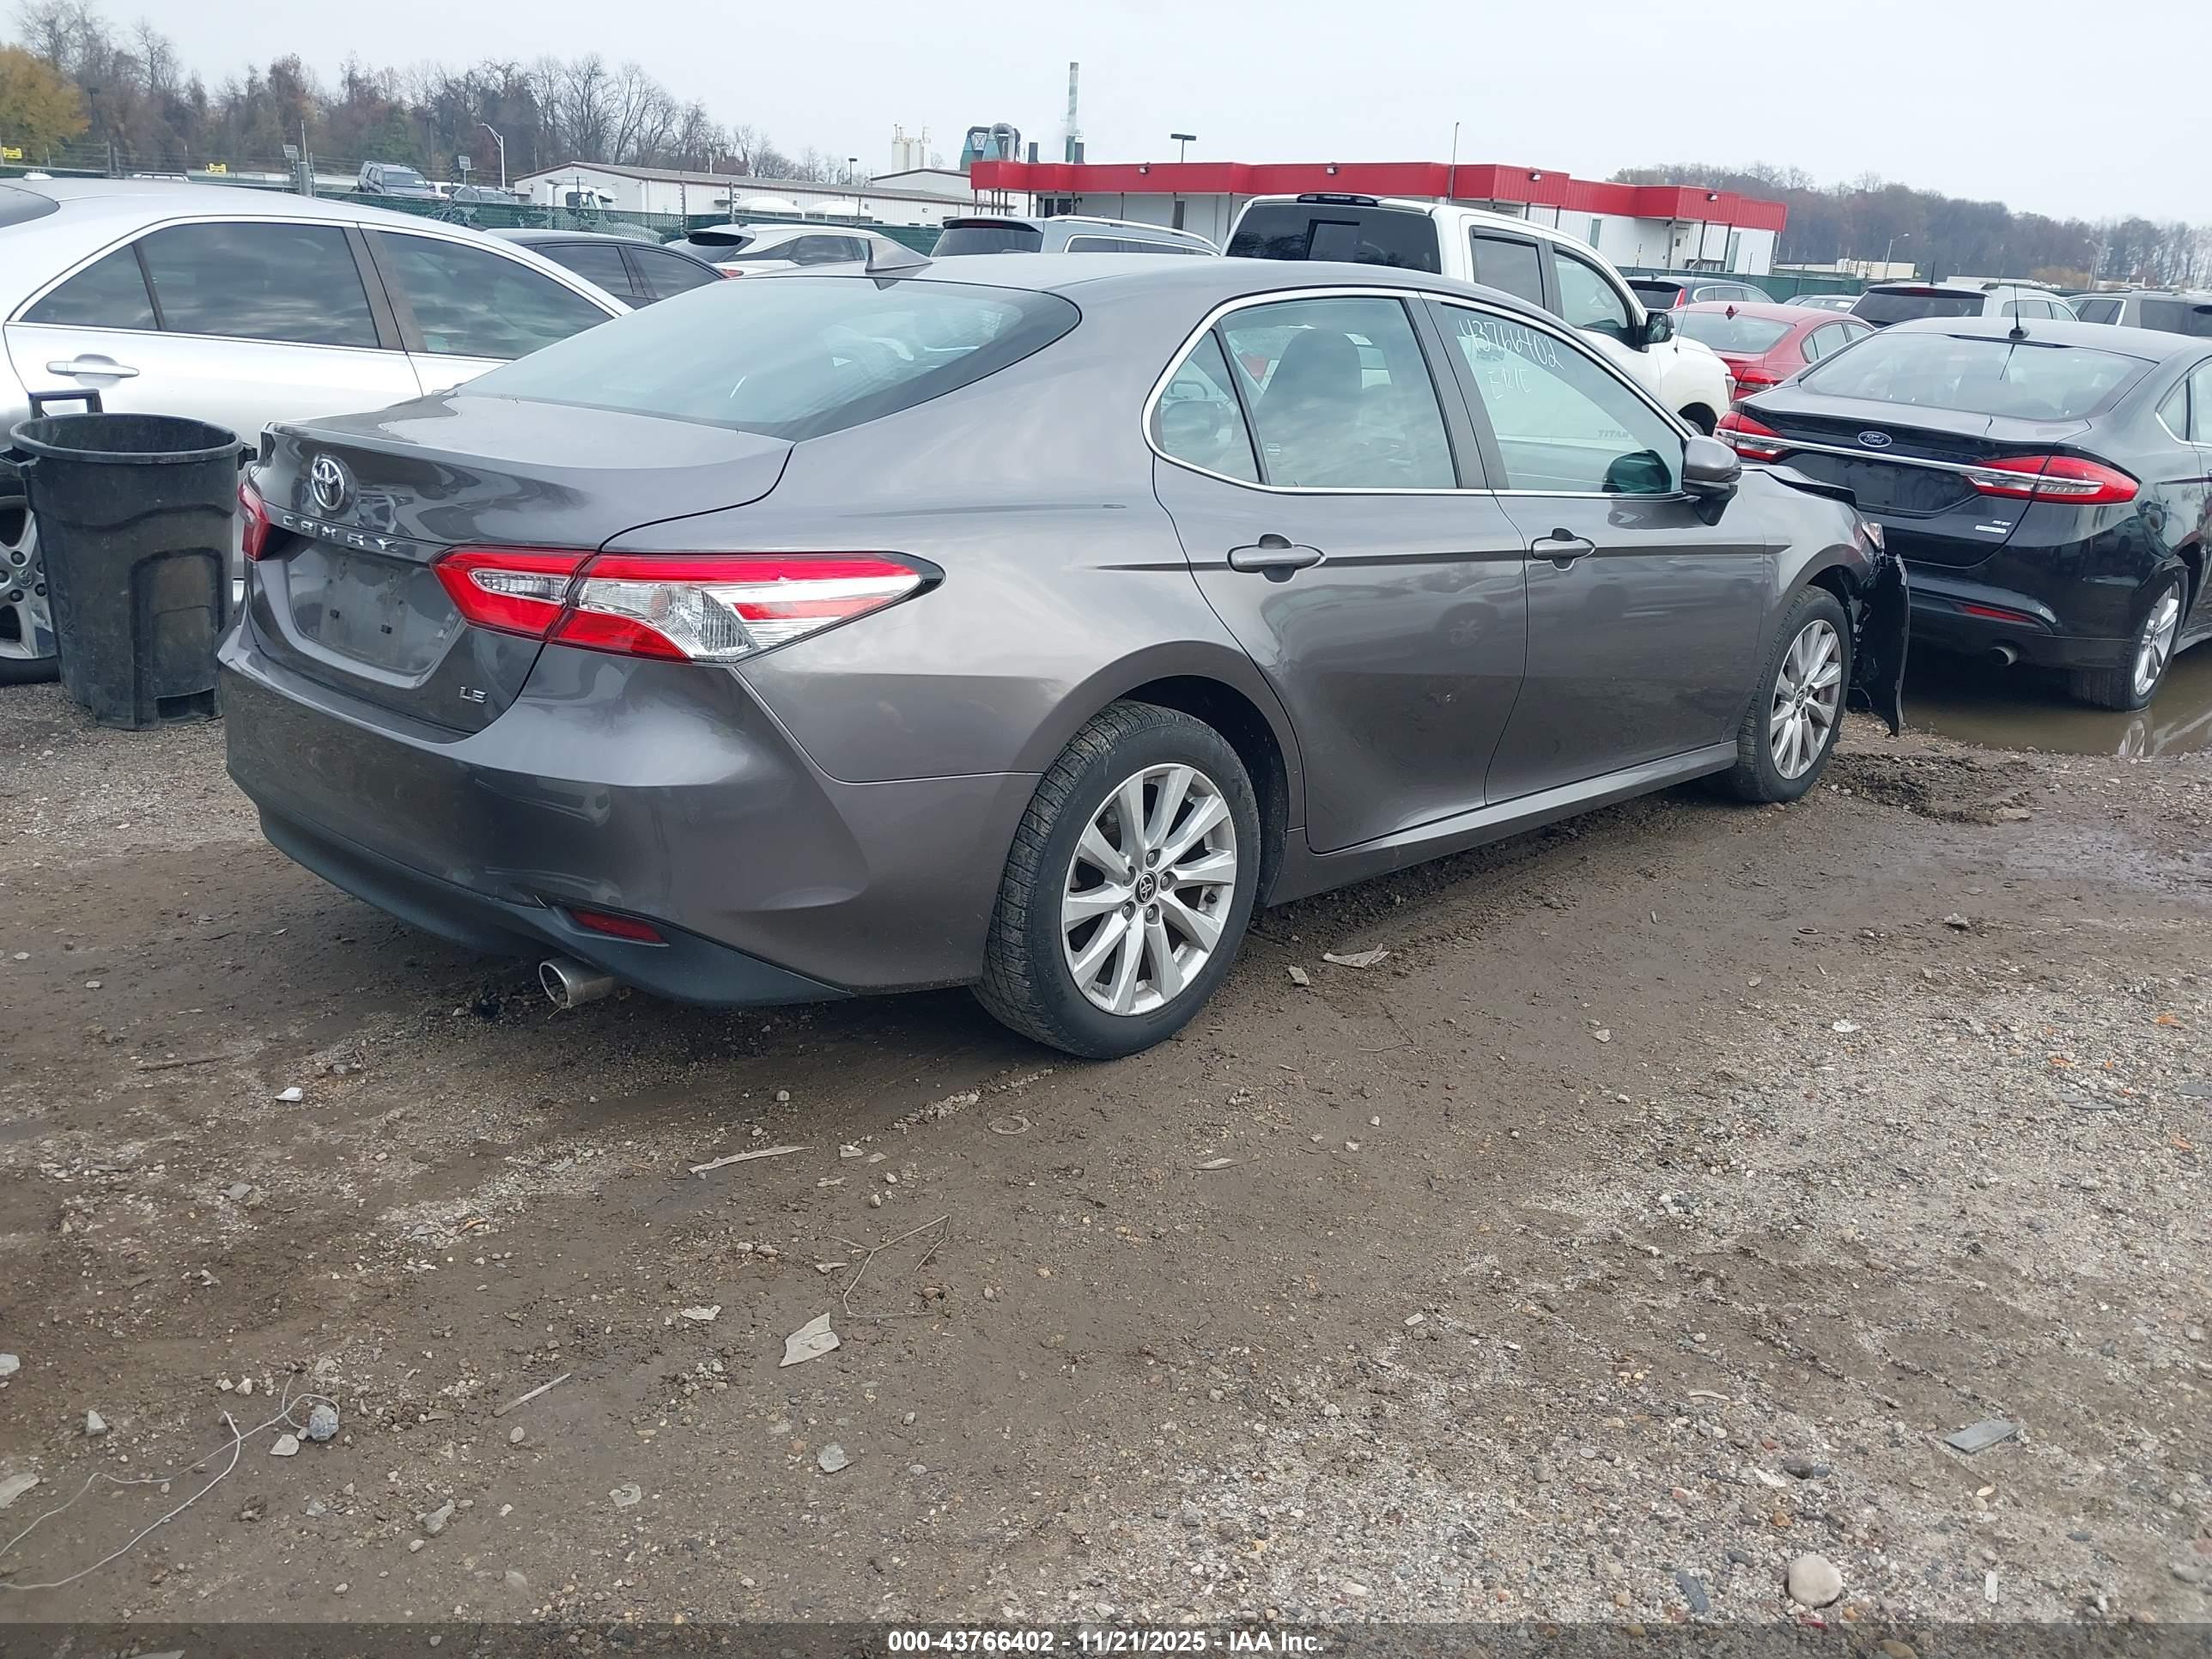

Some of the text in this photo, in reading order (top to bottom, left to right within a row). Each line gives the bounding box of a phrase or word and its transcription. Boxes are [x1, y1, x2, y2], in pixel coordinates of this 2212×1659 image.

[1458, 319, 1565, 370] 43766402
[283, 514, 398, 551] CAMRY
[460, 686, 488, 704] LE
